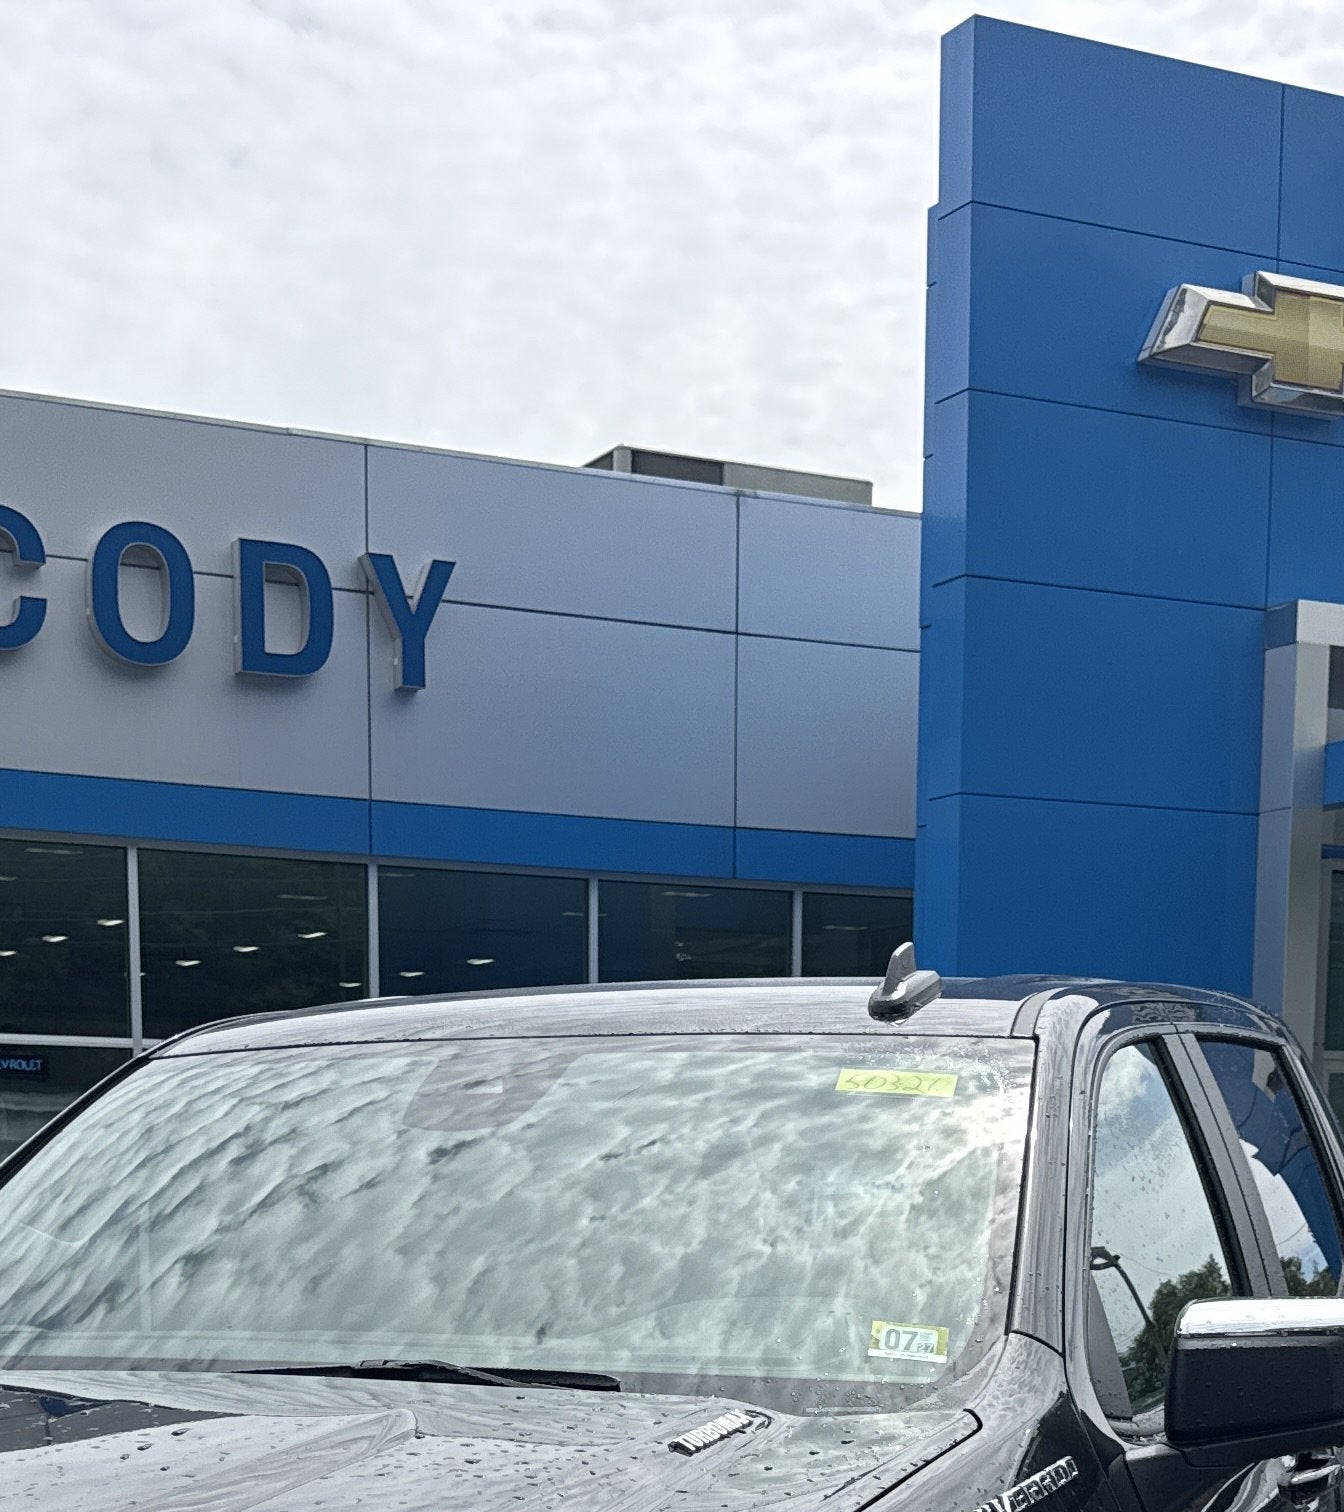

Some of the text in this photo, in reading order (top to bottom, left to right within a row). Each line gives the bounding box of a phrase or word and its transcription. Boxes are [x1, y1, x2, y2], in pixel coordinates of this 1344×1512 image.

[885, 1329, 918, 1351] 07
[917, 1342, 934, 1354] 27
[671, 1408, 753, 1452] TURBOMAX
